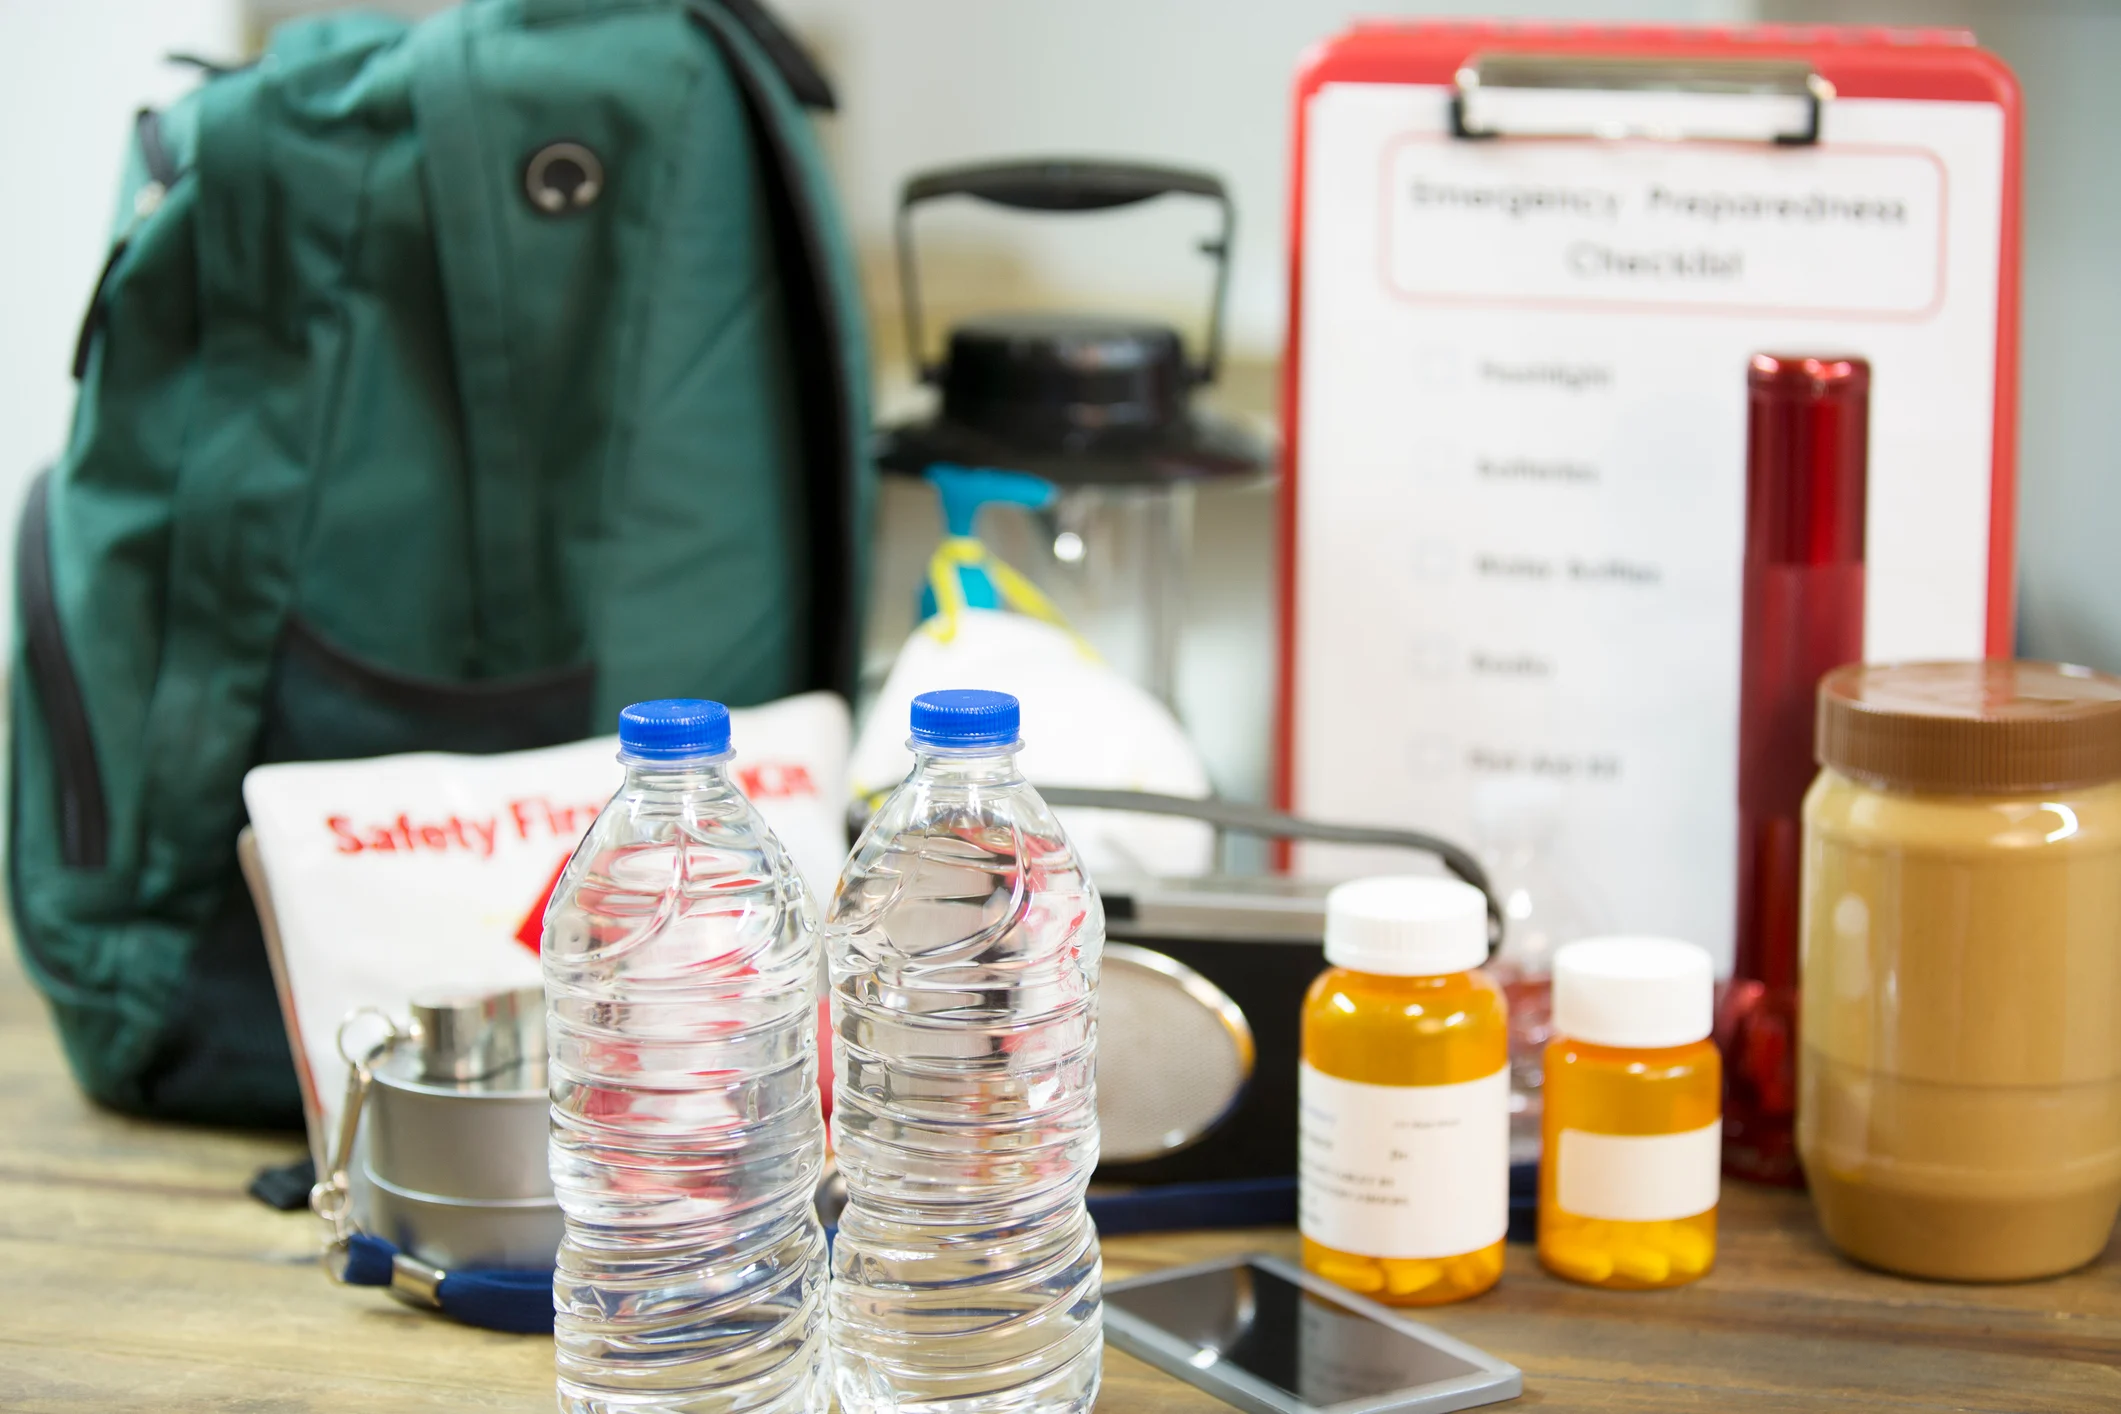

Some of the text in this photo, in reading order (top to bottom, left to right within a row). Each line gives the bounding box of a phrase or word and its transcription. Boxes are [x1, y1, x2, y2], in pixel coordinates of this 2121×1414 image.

[1410, 178, 1908, 225] Emergency Preparedness
[1564, 240, 1743, 281] Checklist
[326, 814, 496, 860] Safety
[508, 793, 612, 840] Fir
